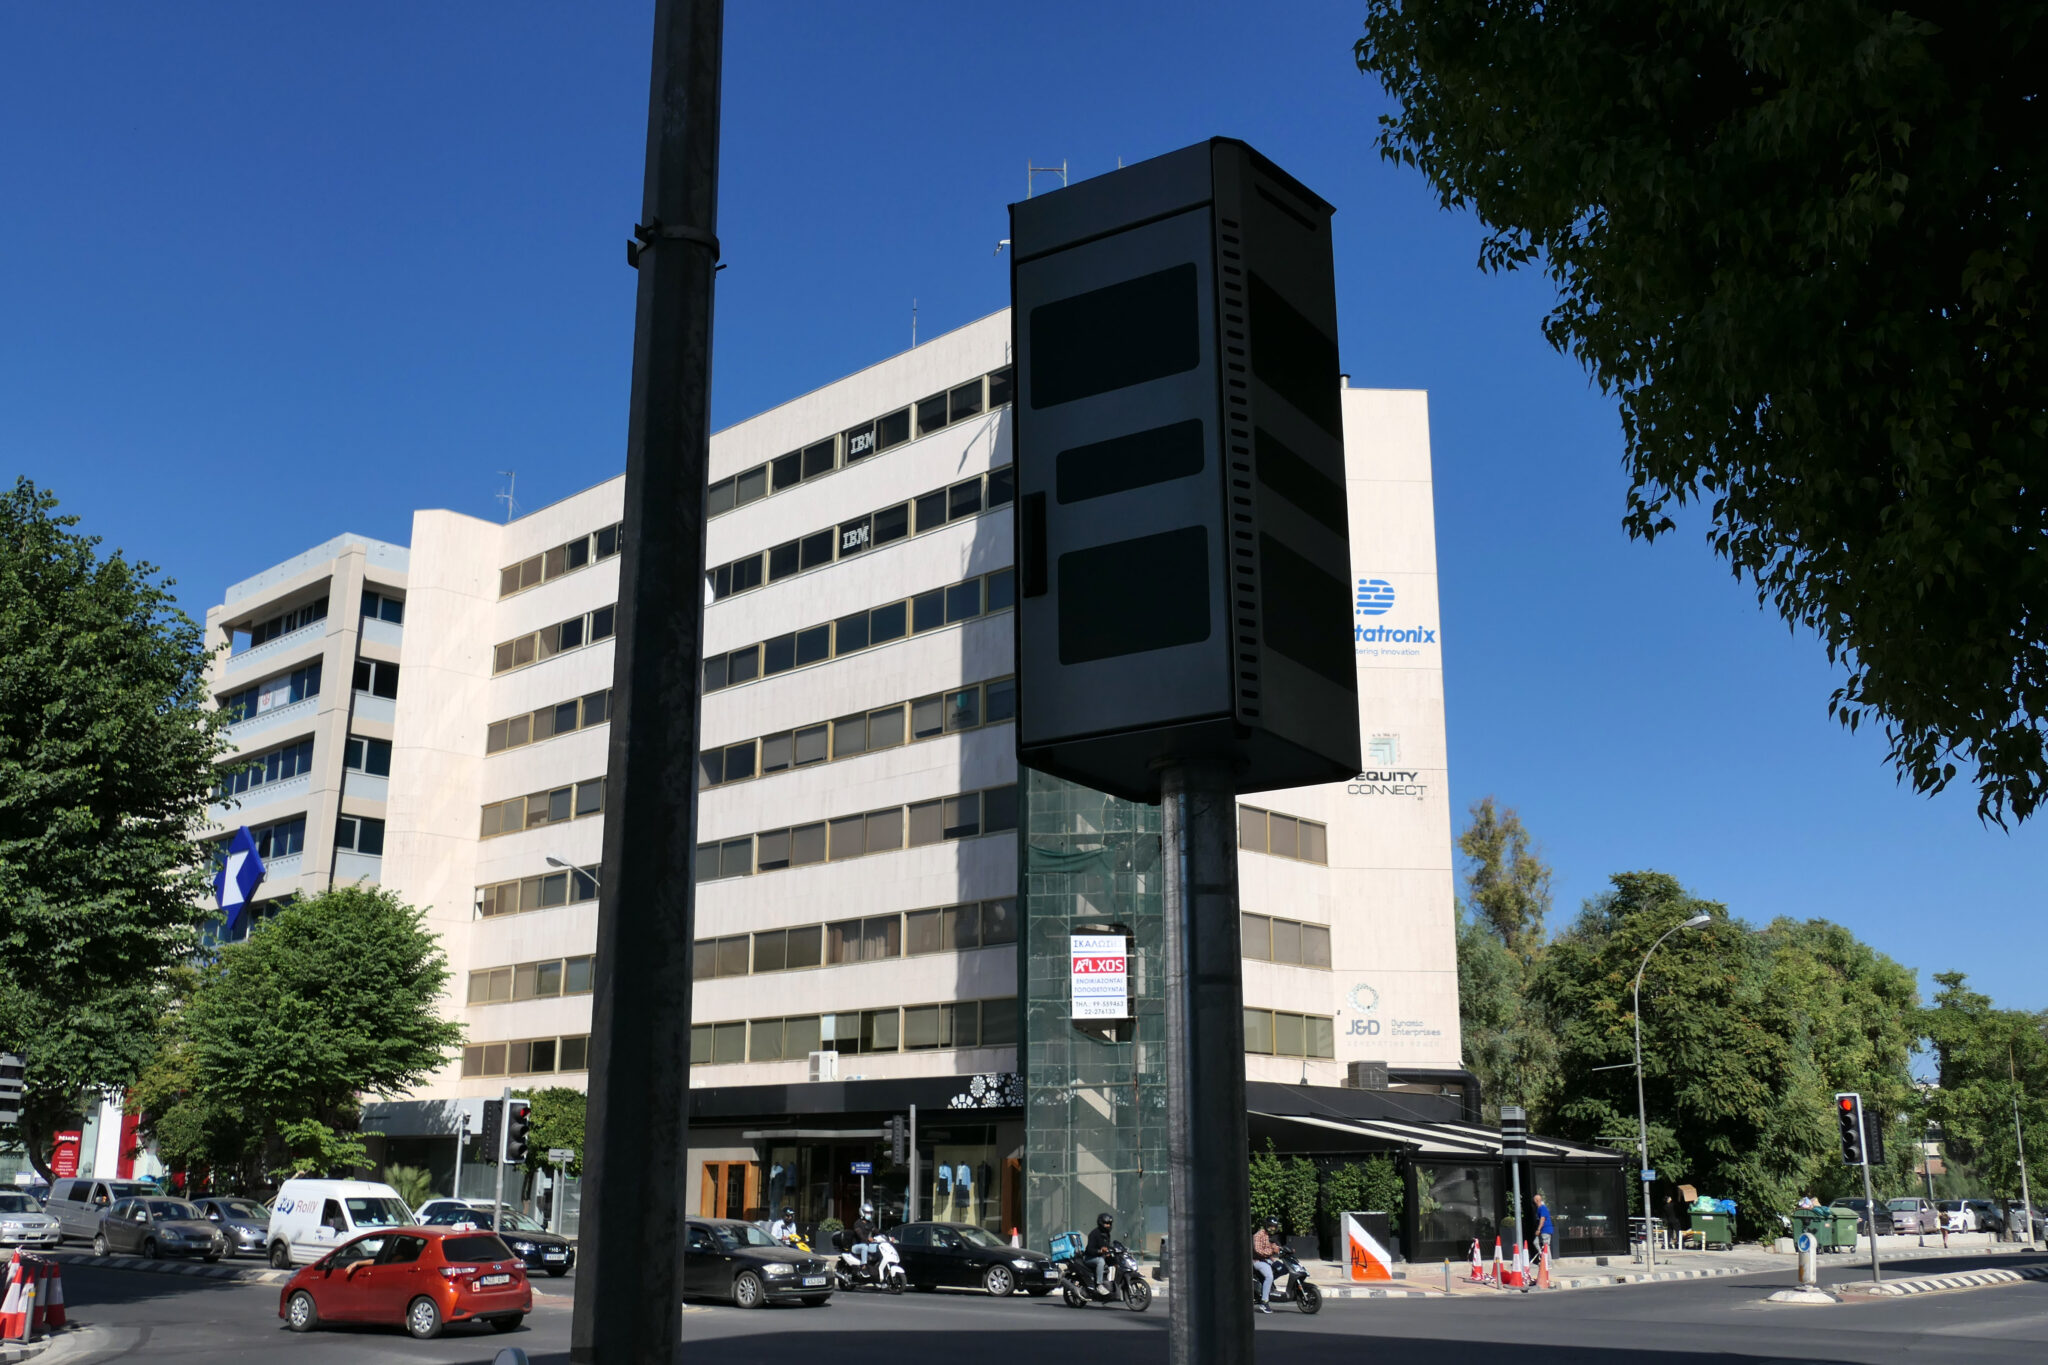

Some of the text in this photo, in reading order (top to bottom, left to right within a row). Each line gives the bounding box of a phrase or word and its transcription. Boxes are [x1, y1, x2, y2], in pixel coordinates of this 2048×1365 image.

[850, 431, 874, 454] IBM
[843, 526, 869, 549] IBM
[1355, 771, 1418, 782] EQUITY
[1347, 784, 1428, 795] CONNECT
[1345, 1019, 1380, 1035] J&D
[1391, 1028, 1441, 1036] Enterprises
